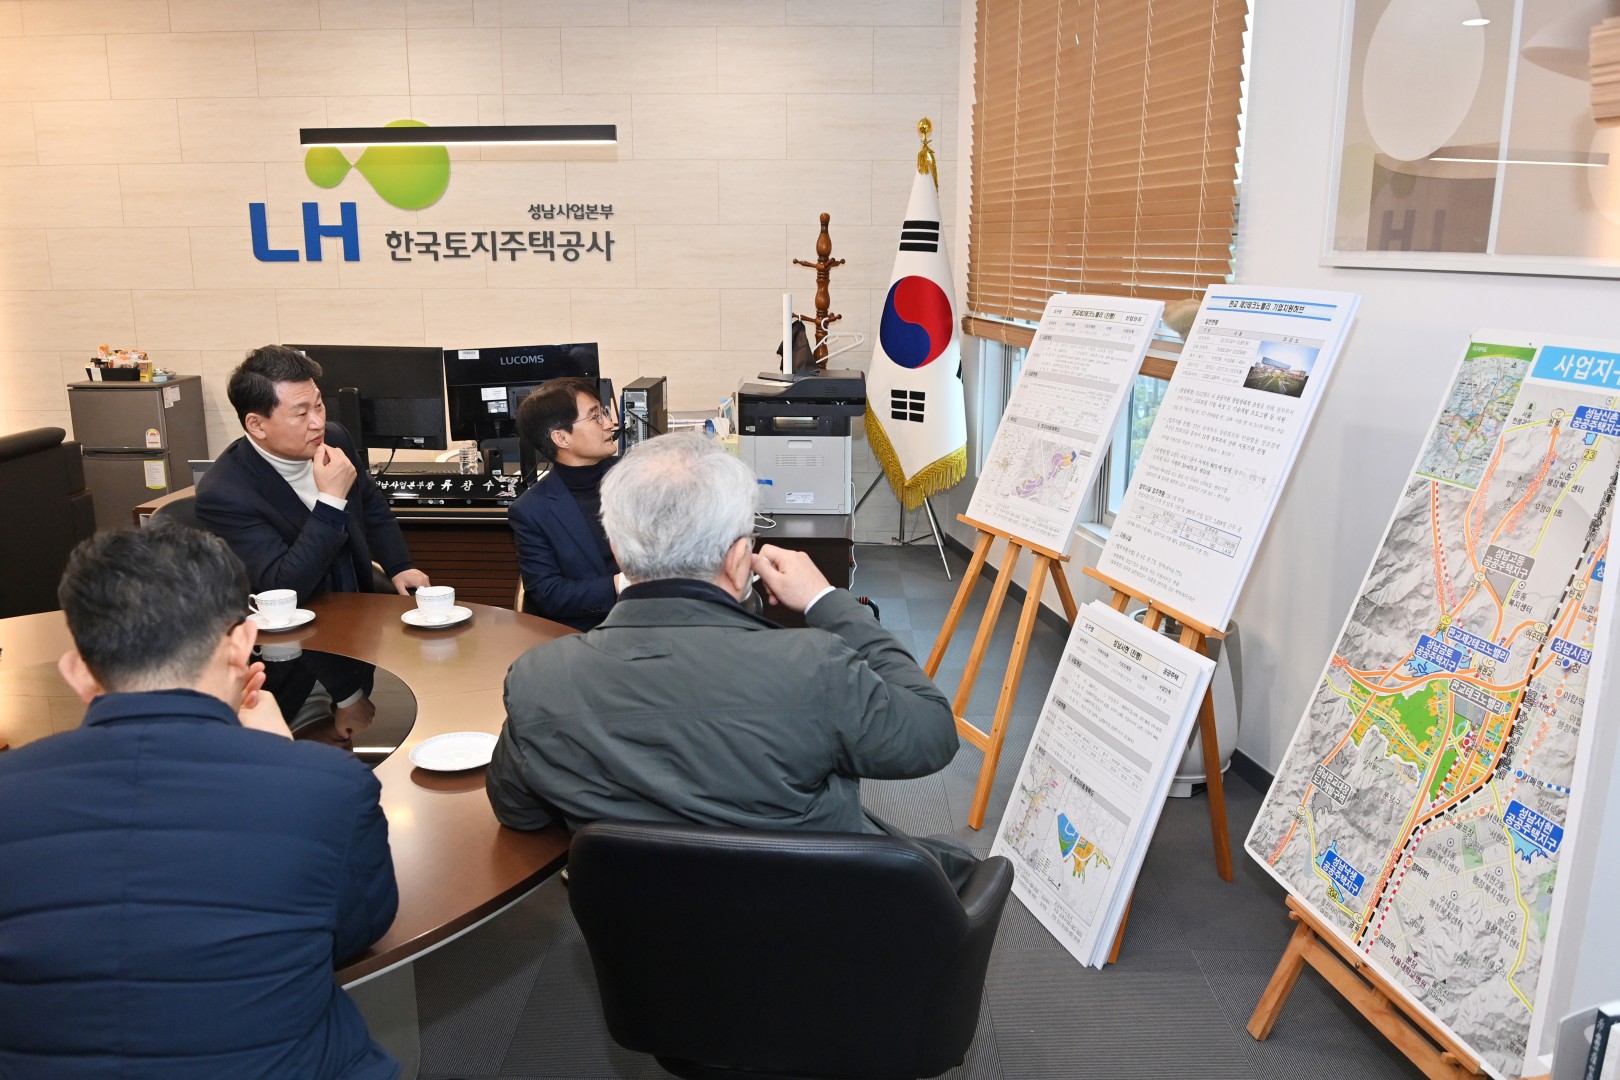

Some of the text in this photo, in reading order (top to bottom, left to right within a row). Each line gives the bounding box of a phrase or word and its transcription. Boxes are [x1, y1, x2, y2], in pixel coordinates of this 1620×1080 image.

[527, 204, 615, 220] 성남사업본부
[249, 202, 361, 262] LH
[385, 230, 615, 262] 한국토지주택공사
[500, 354, 545, 366] LUCOMS
[1585, 408, 1619, 425] 성남신촌
[1583, 450, 1596, 459] 23
[1483, 555, 1529, 579] 공공주택지구
[1494, 548, 1526, 567] 성남고등
[1416, 644, 1457, 671] 공공주택지구
[1426, 638, 1455, 659] 성남금토
[1448, 626, 1508, 663] 판교제2테크노밸리
[1554, 639, 1592, 663] 성남시청
[1451, 682, 1505, 714] 판교테크노밸리
[1505, 812, 1558, 850] 공공주택지구
[1519, 807, 1555, 835] 성남서현
[1322, 860, 1360, 895] 공공주택지구
[1472, 875, 1511, 907] 행정복지센터
[1390, 954, 1428, 990] 서울대학교병원
[1405, 956, 1418, 970] 분당
